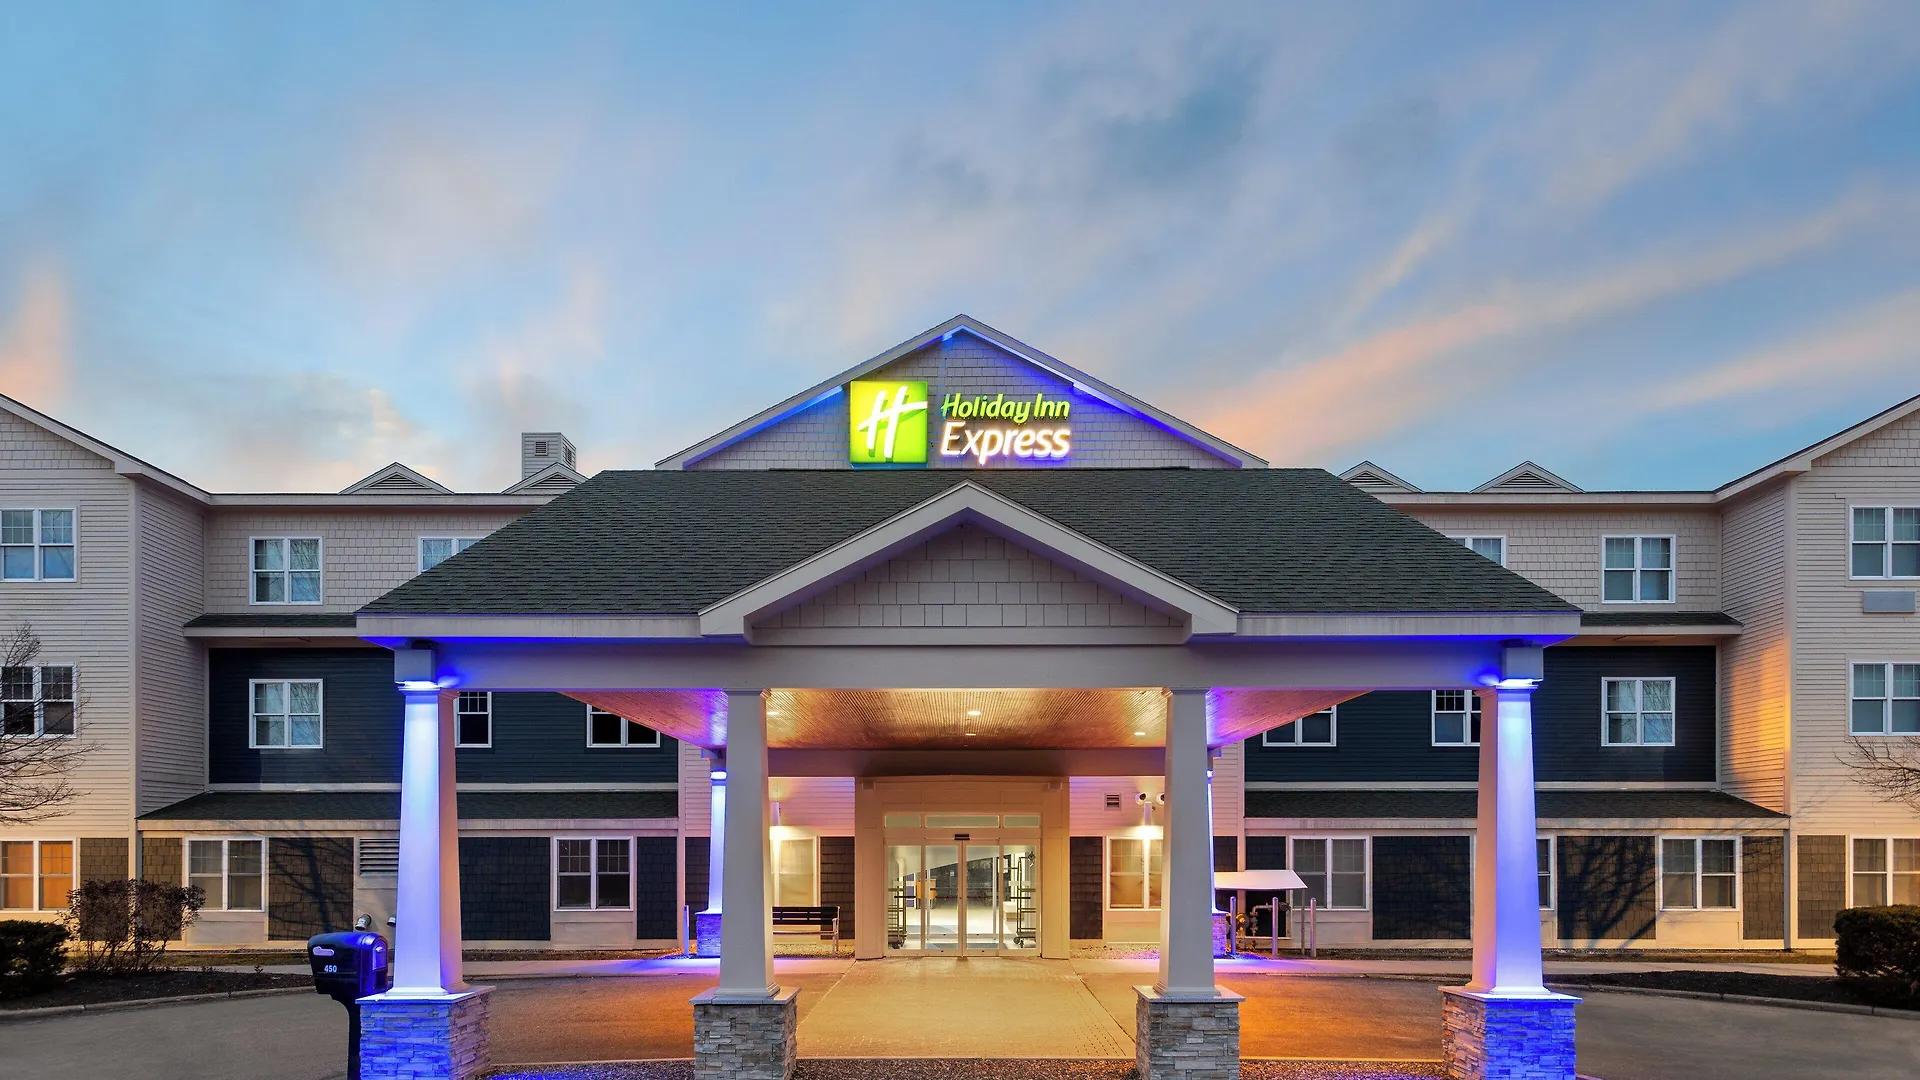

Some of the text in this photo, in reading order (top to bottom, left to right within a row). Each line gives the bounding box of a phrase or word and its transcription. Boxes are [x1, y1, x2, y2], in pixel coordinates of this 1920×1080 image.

[941, 393, 1070, 423] Holiday Inn
[941, 421, 1071, 465] Express
[324, 965, 338, 973] 450
